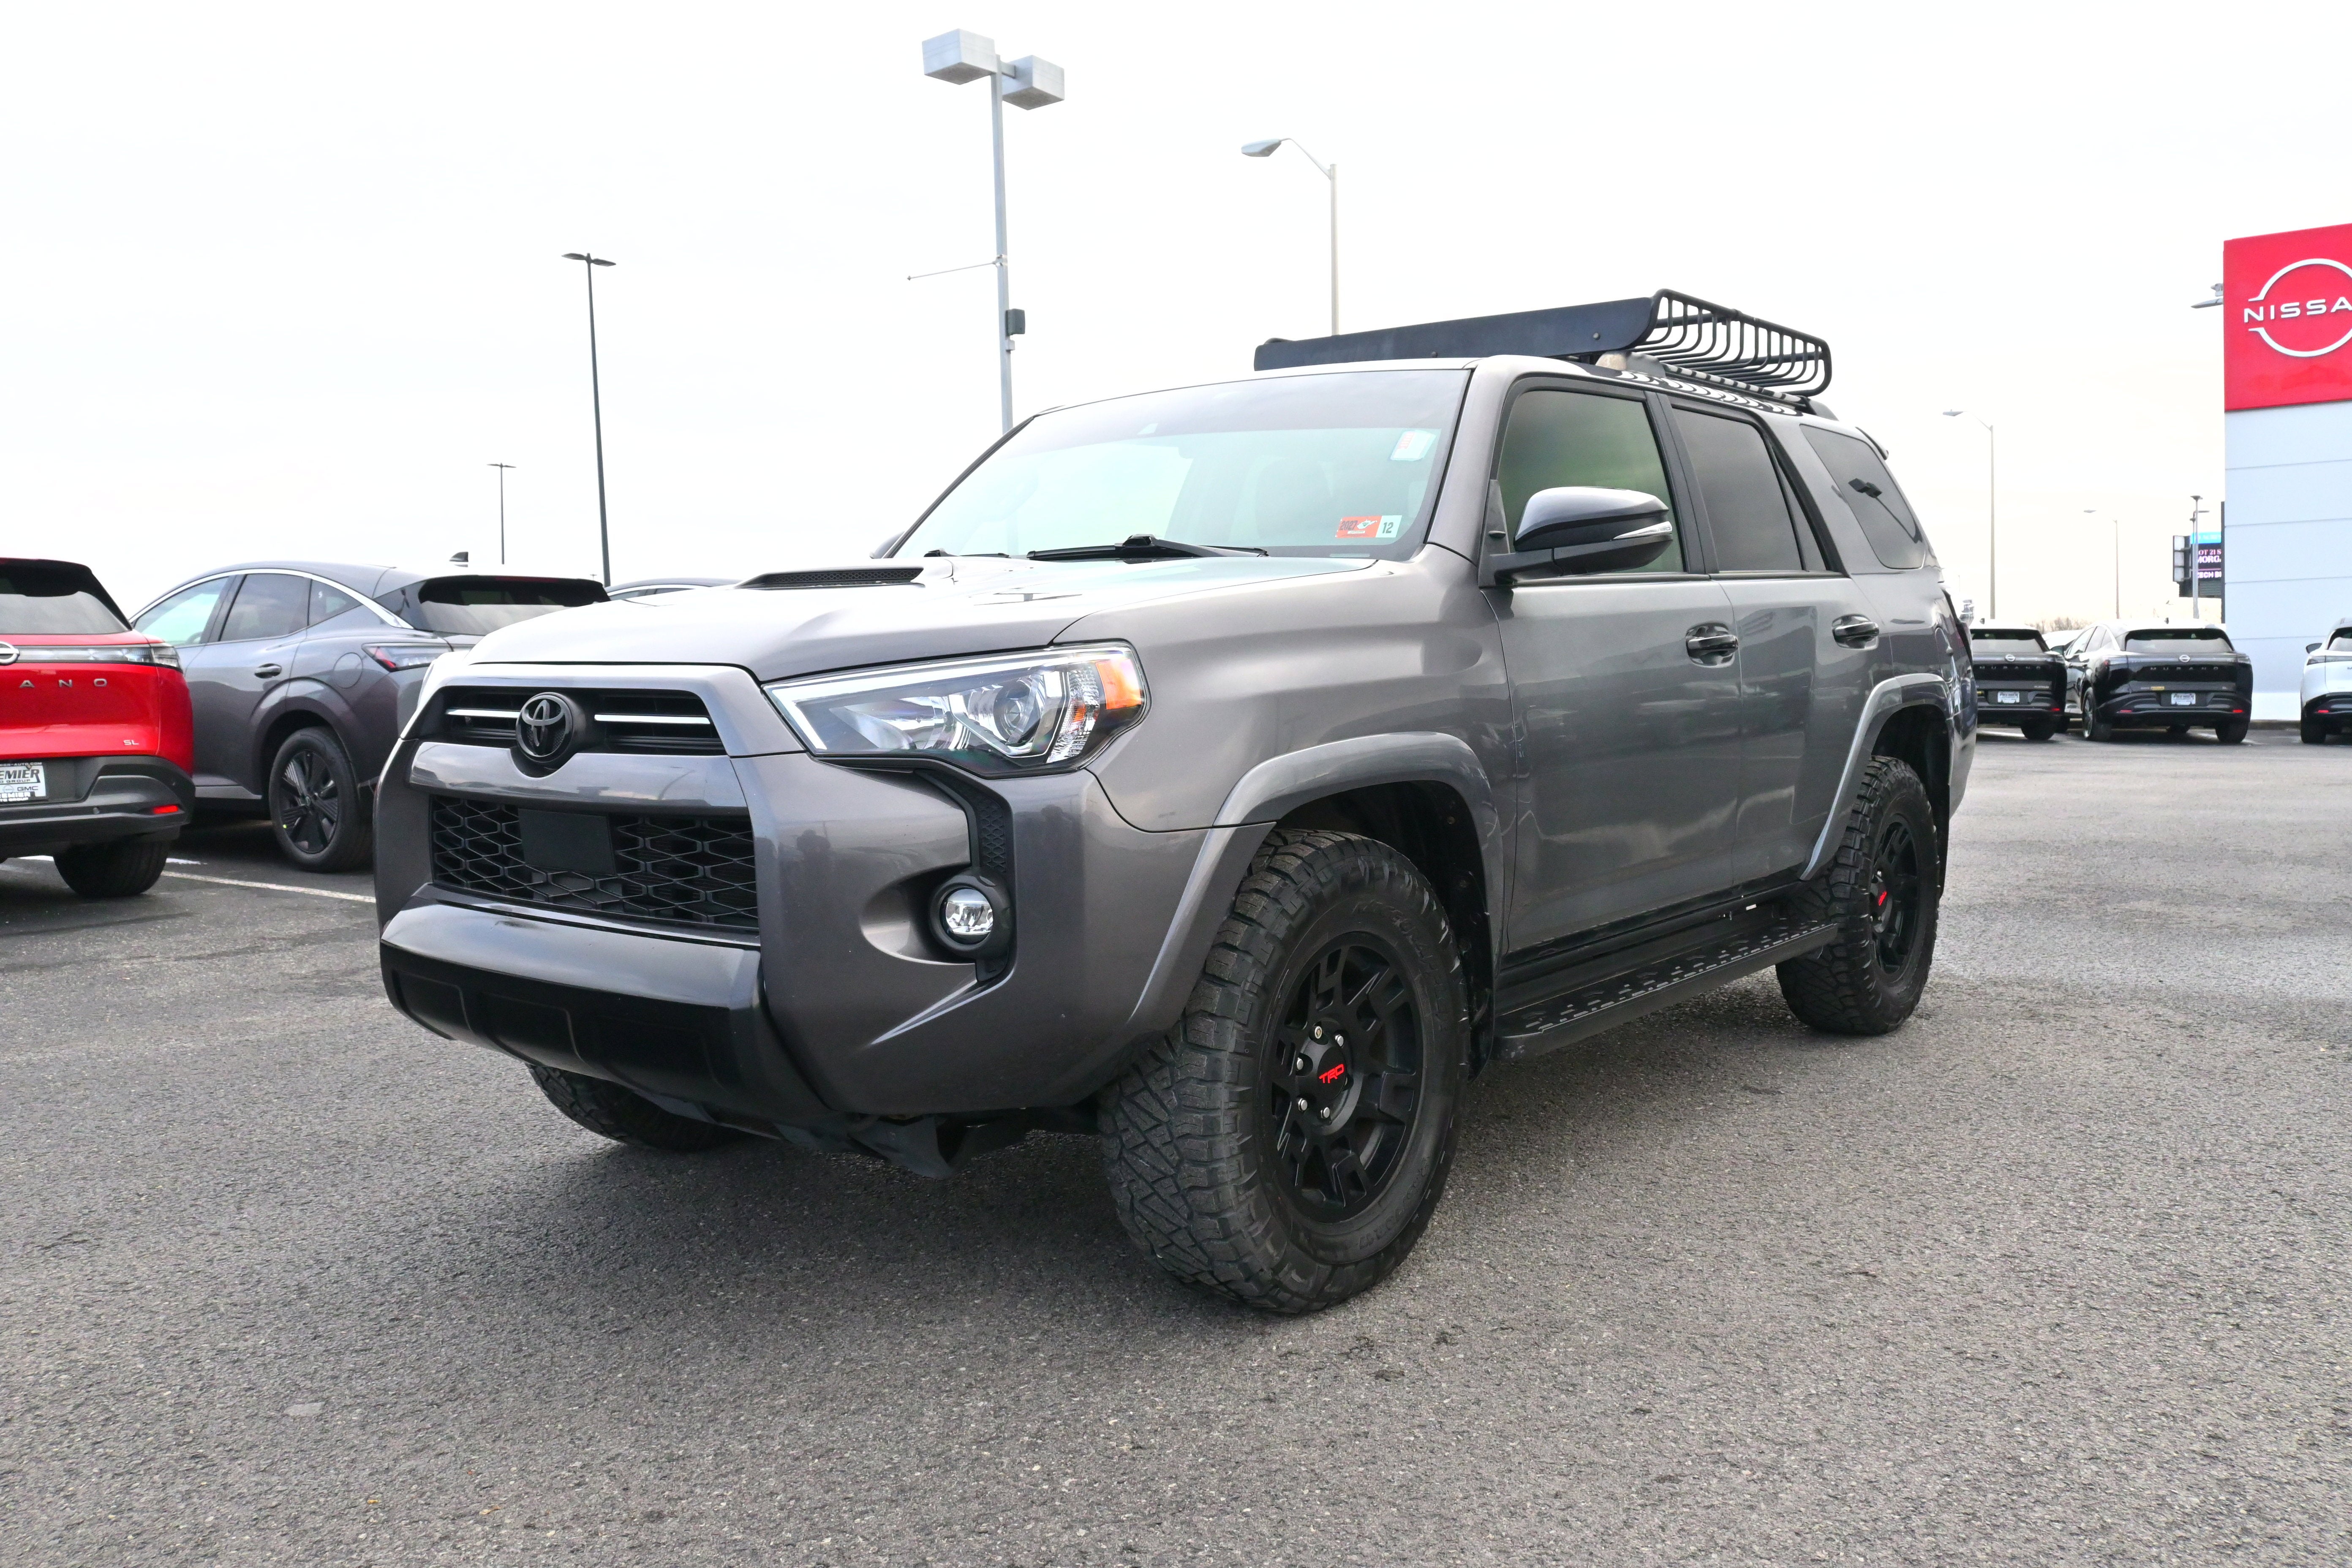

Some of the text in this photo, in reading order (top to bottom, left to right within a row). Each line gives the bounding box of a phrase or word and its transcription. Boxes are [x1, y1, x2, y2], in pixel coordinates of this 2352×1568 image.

[2244, 297, 2352, 323] NISSA
[1339, 520, 1358, 531] 2027
[1382, 522, 1394, 534] 12
[1319, 1064, 1345, 1083] TRD
